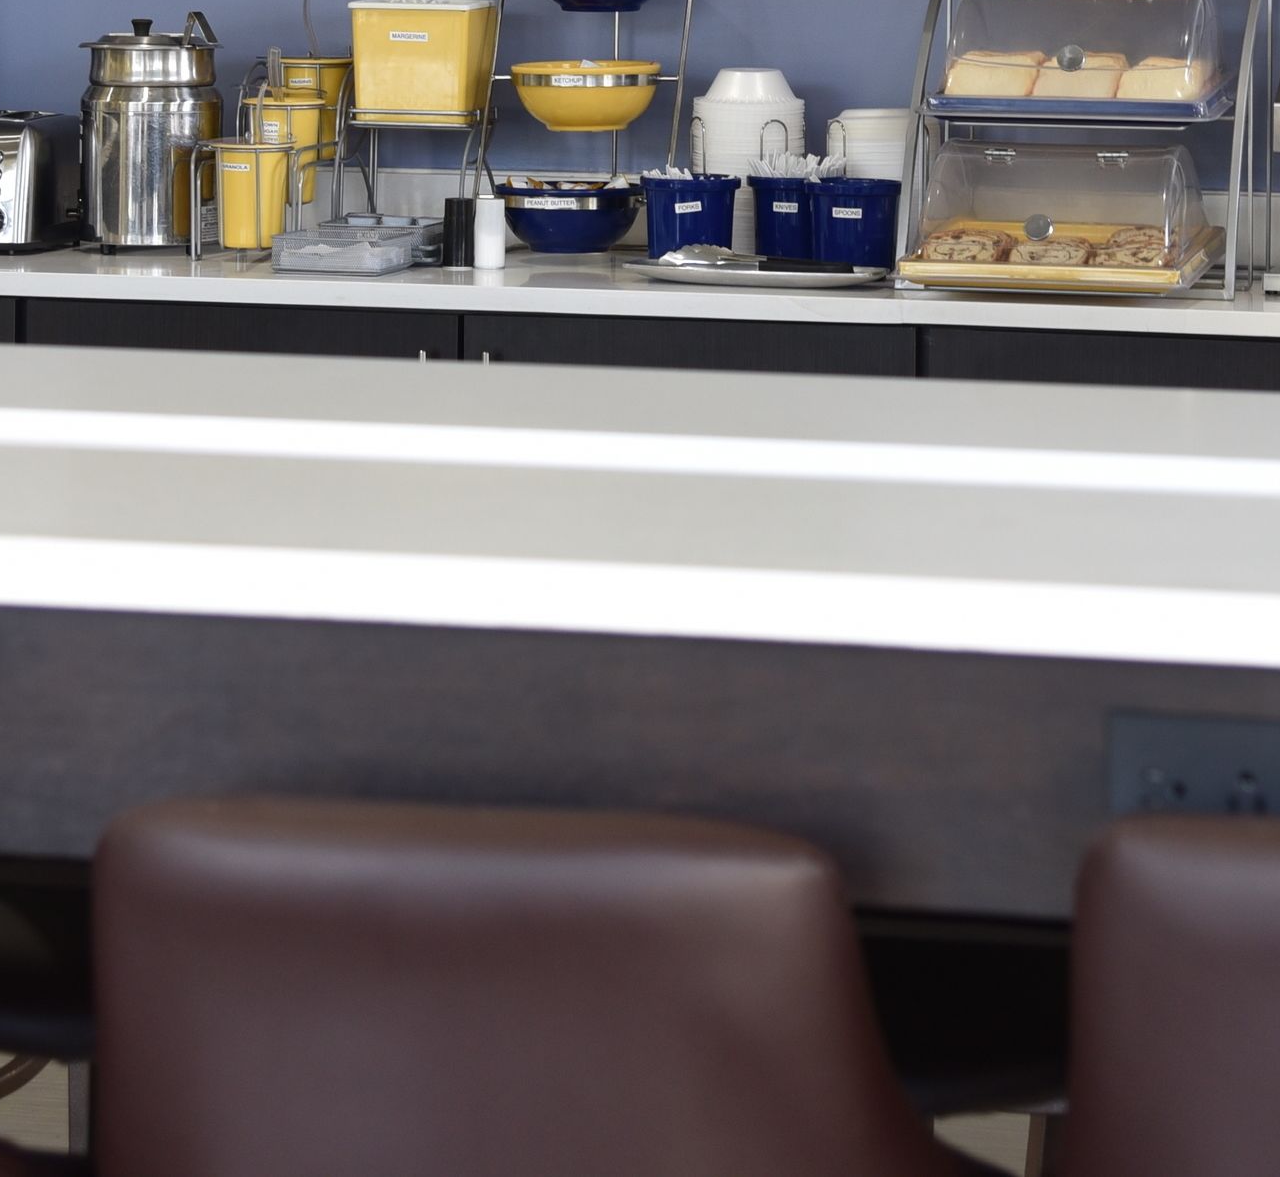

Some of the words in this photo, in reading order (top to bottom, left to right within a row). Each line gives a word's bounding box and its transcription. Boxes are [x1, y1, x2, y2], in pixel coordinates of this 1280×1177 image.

[527, 199, 549, 207] PEANUT
[551, 199, 575, 207] BUTTER
[677, 203, 700, 212] FORKS
[774, 203, 798, 212] KNIVES
[834, 208, 862, 217] SPOONS
